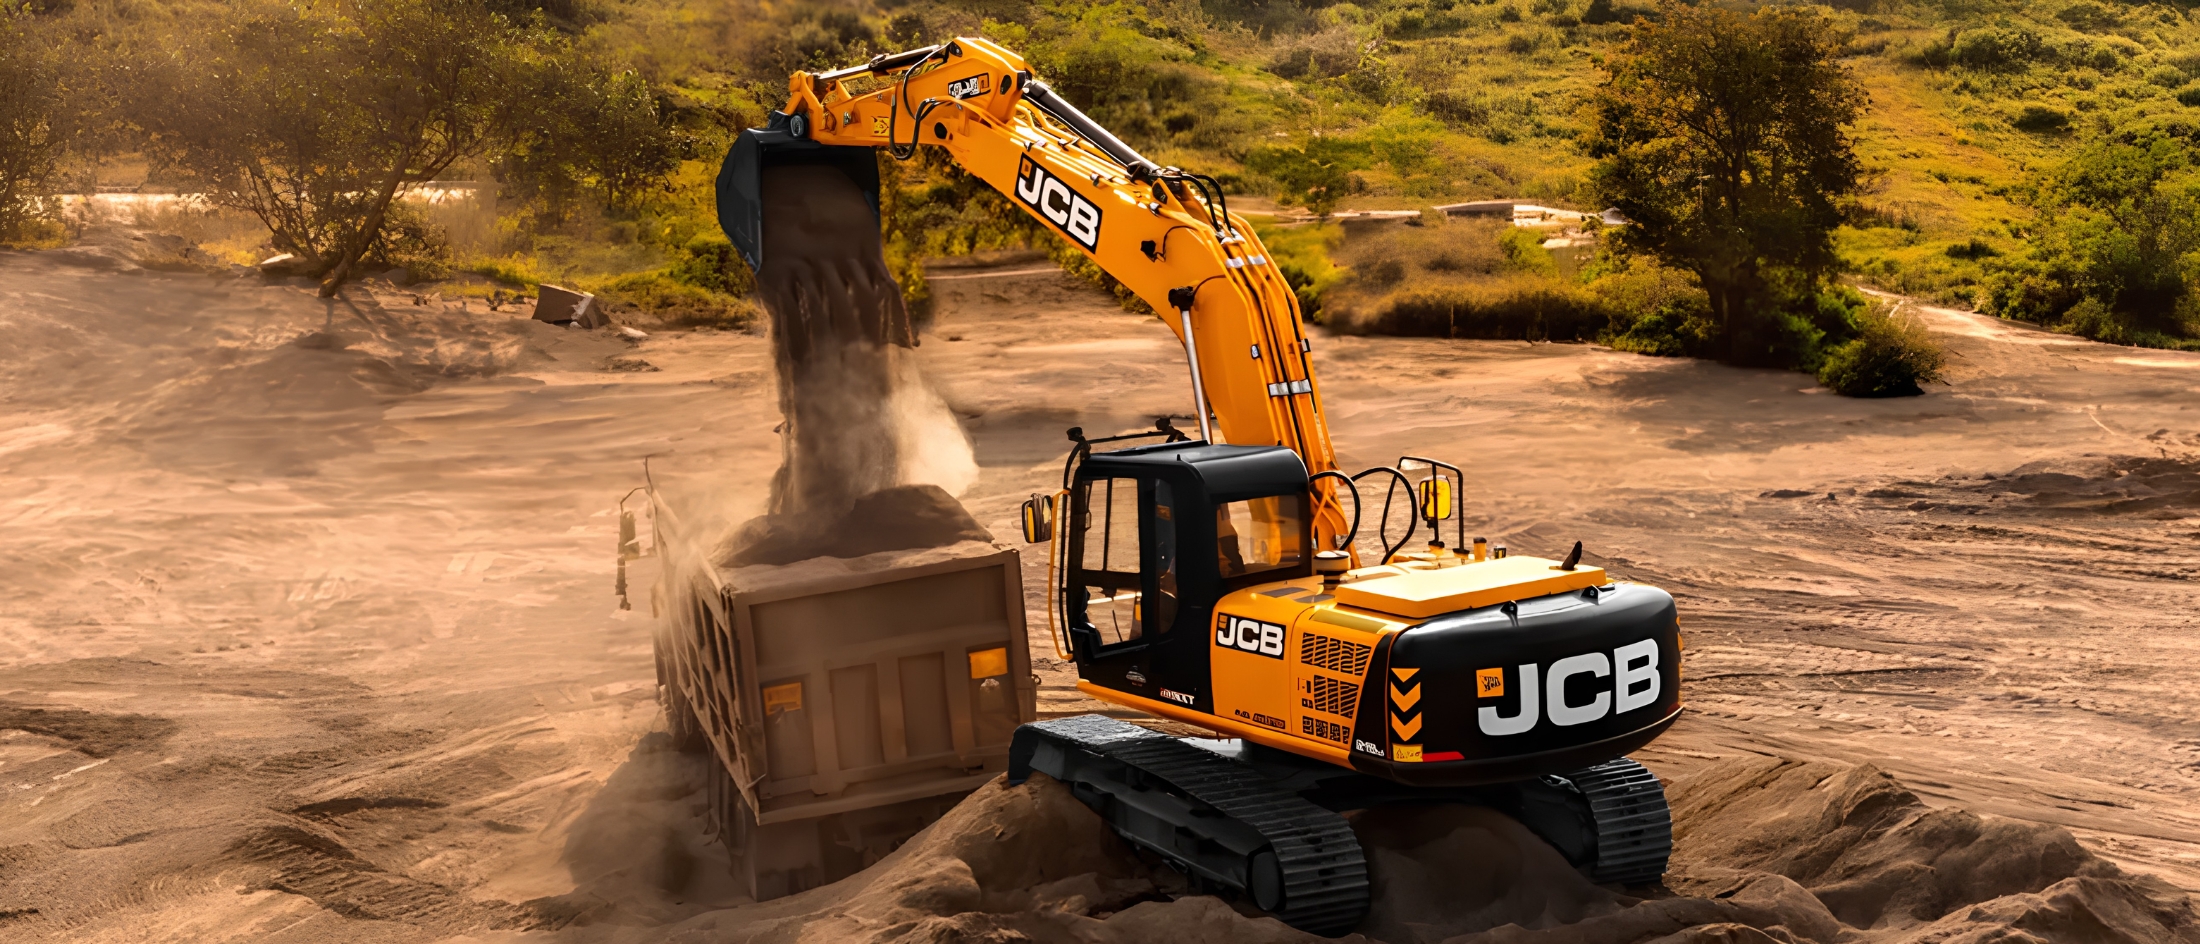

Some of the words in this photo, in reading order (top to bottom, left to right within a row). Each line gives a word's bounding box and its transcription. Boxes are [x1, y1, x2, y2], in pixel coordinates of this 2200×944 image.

[1018, 167, 1099, 247] JCB
[1217, 616, 1284, 657] JCB
[1478, 638, 1660, 736] JCB
